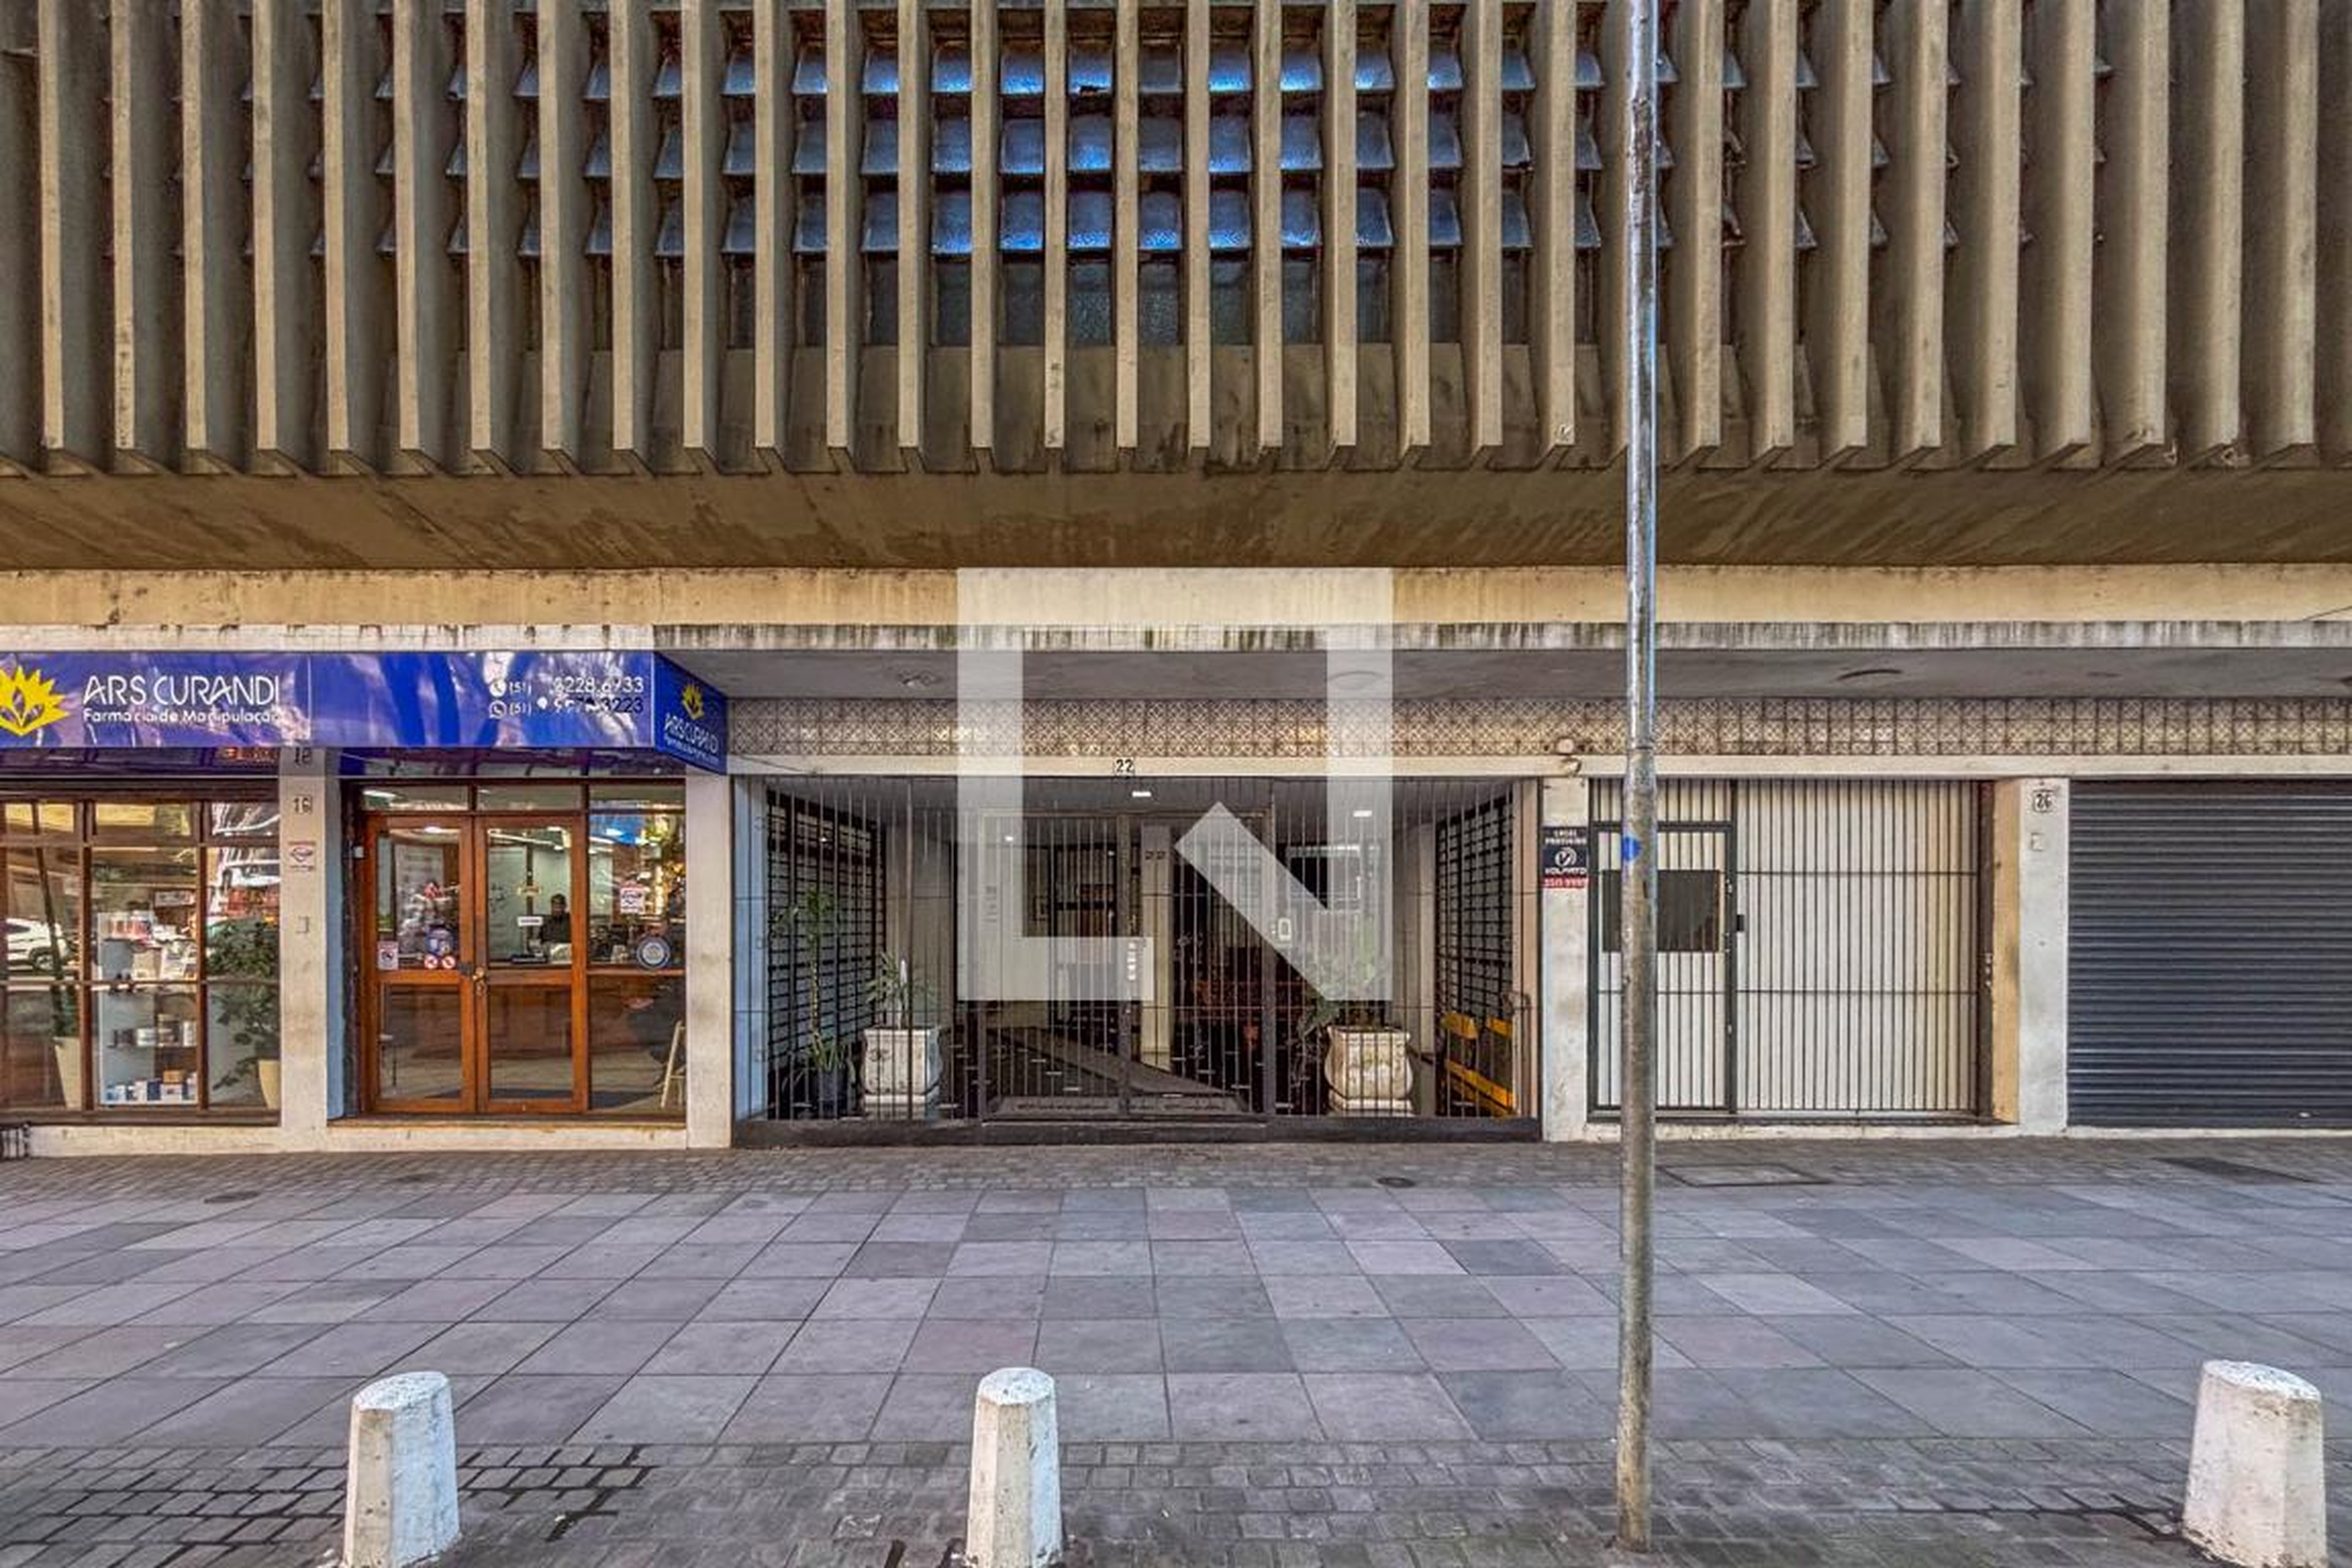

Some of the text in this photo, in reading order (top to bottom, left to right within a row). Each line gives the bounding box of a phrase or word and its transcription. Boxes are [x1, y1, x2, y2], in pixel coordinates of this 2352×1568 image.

[83, 675, 279, 705] ARS CURANDI
[1116, 758, 1133, 773] 22
